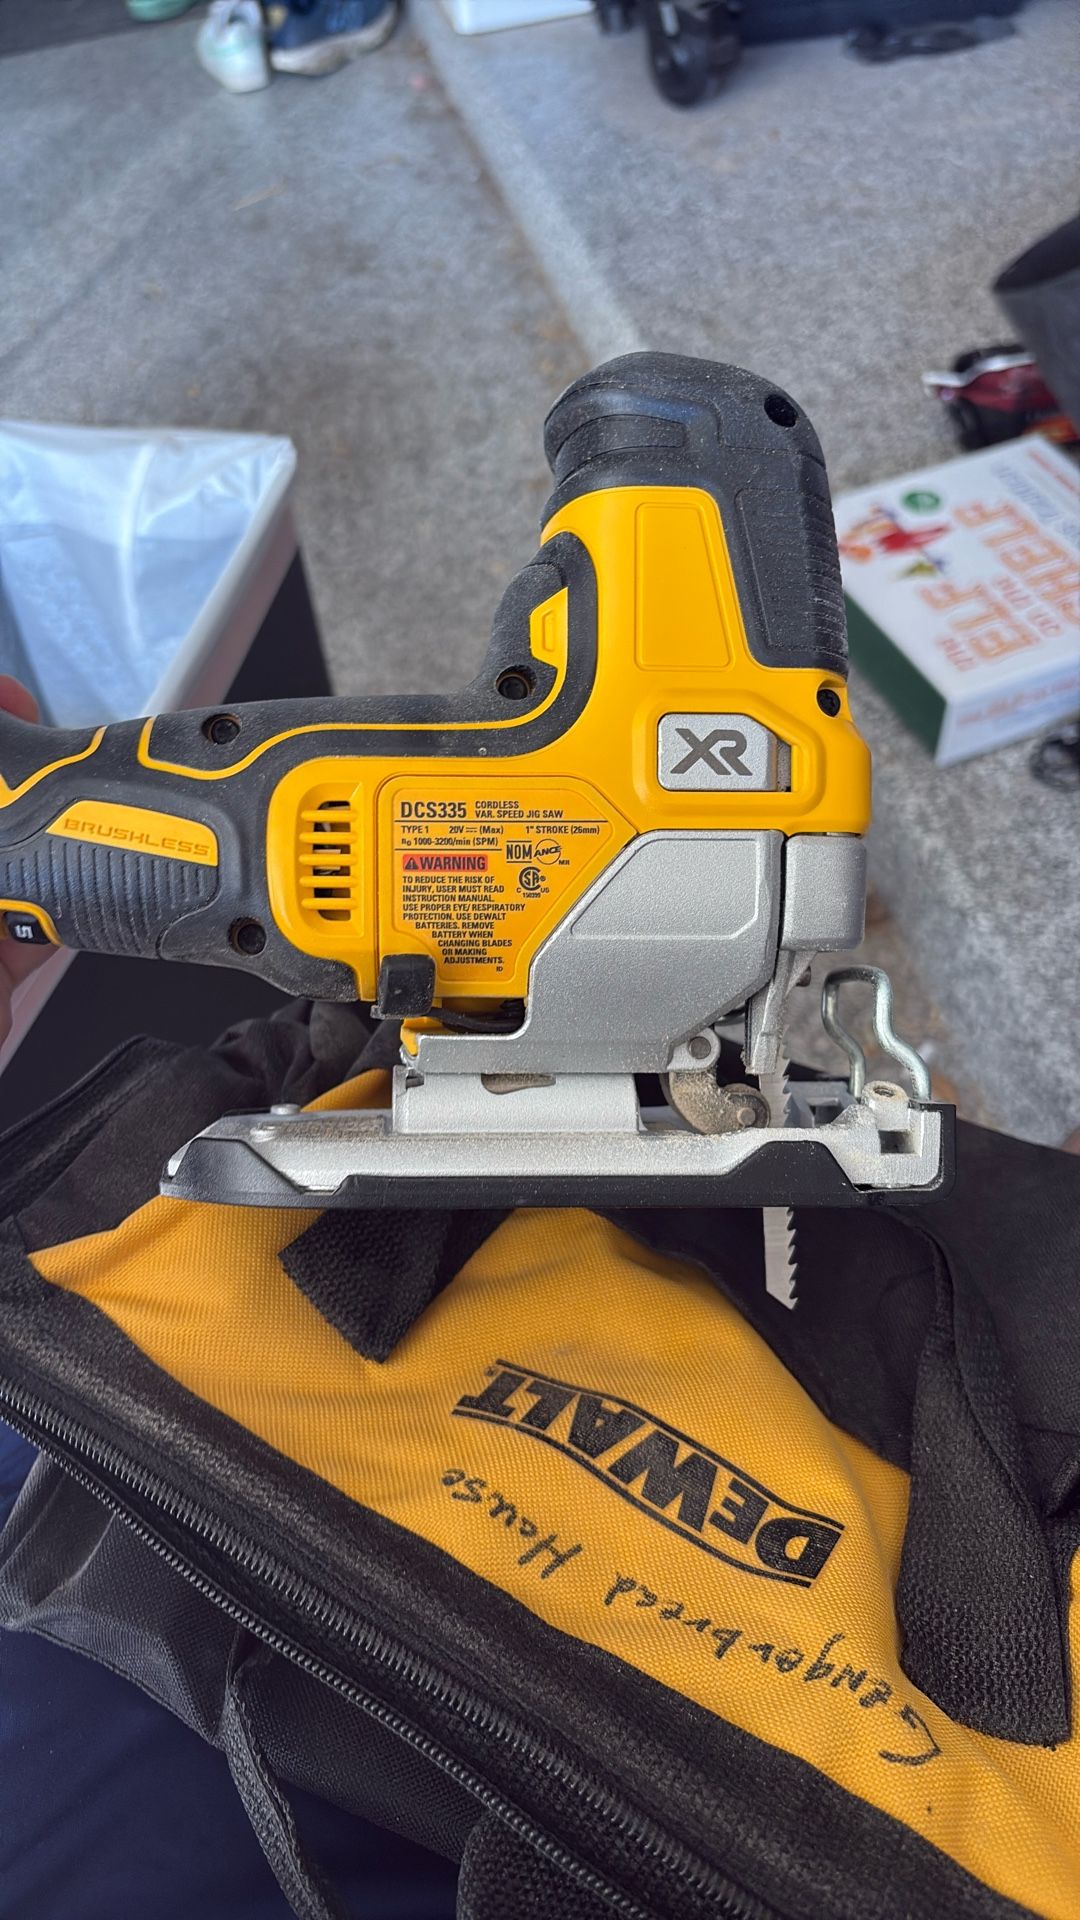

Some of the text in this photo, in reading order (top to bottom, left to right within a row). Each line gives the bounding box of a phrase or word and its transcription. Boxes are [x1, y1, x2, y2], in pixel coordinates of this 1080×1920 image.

[917, 578, 1040, 661] ELF
[670, 728, 753, 776] XR
[401, 801, 519, 819] DCS335 CORDLESS
[475, 810, 563, 819] VAR. SPEED JIG SAW
[63, 818, 209, 856] BRUSHLESS
[401, 825, 600, 836] TYPE 1 20V (Max) 1" STROKE (26mm)
[414, 837, 471, 847] 1000-3200/min
[473, 837, 498, 848] (SPM)
[507, 844, 561, 859] NOM ANCE
[420, 857, 486, 870] WARNING
[402, 885, 505, 894] INJURY, USER MUST READ
[402, 894, 456, 902] INSTRUCTION
[403, 913, 453, 921] PROTECTION.
[459, 1367, 844, 1580] DEWALT
